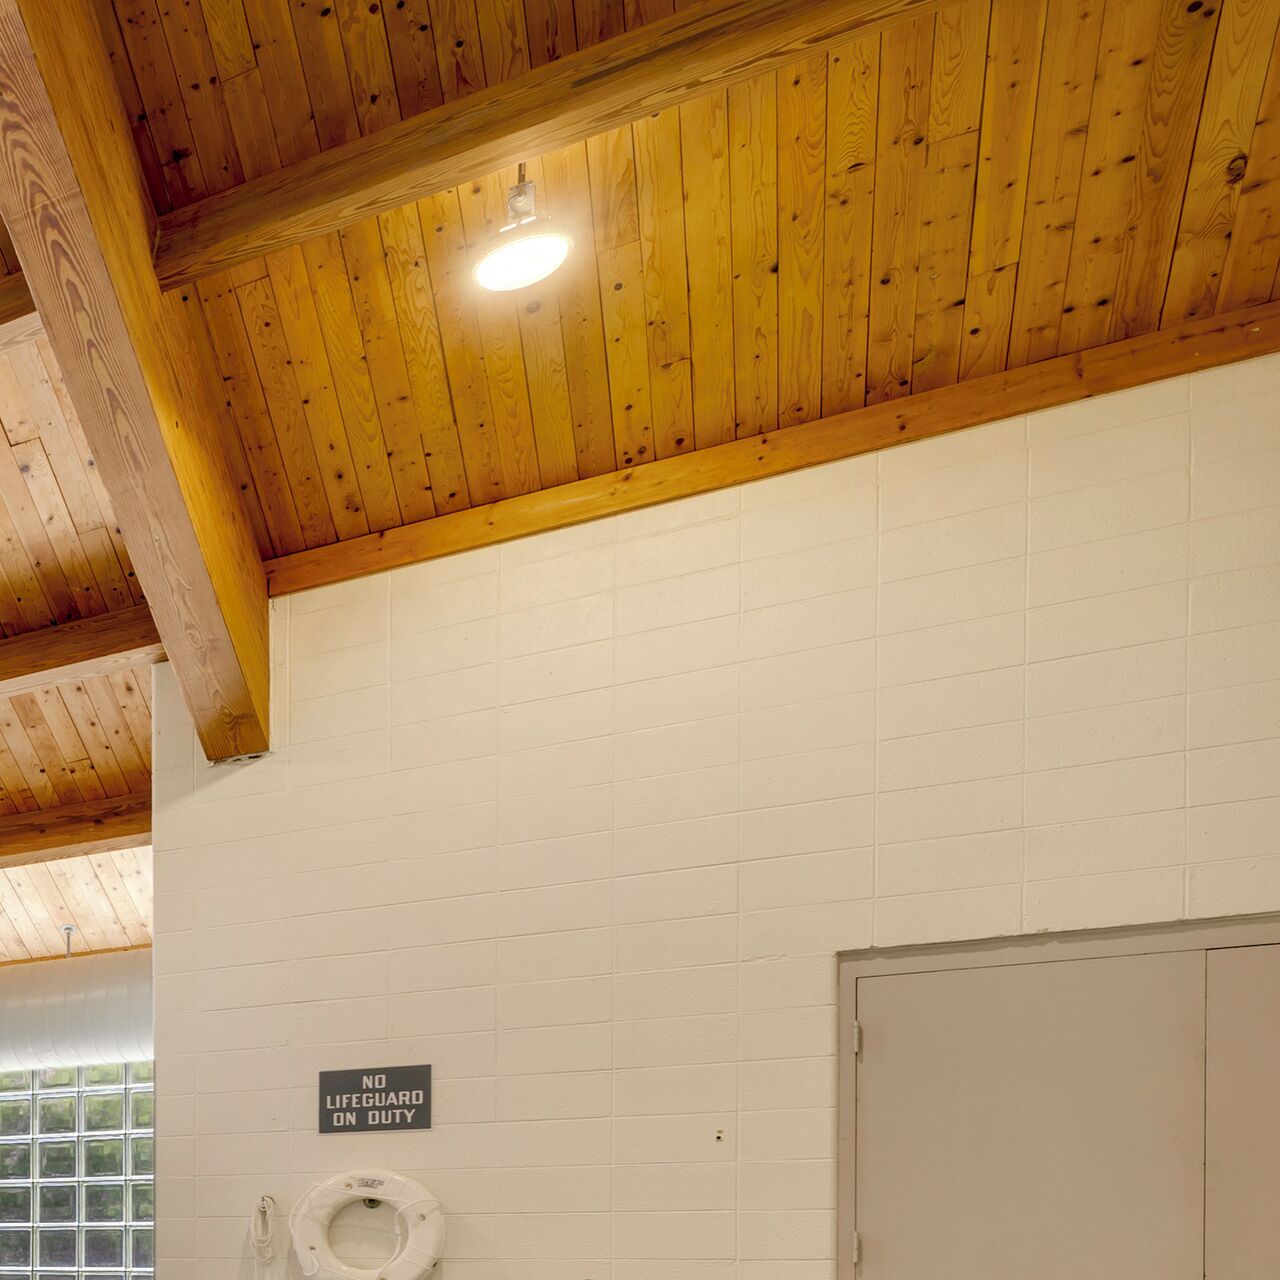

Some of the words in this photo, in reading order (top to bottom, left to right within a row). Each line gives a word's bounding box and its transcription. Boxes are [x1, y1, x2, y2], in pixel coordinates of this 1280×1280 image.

[362, 1074, 386, 1090] NO
[327, 1090, 424, 1109] LIFEGUARD
[333, 1112, 356, 1126] ON
[368, 1109, 416, 1125] DUTY
